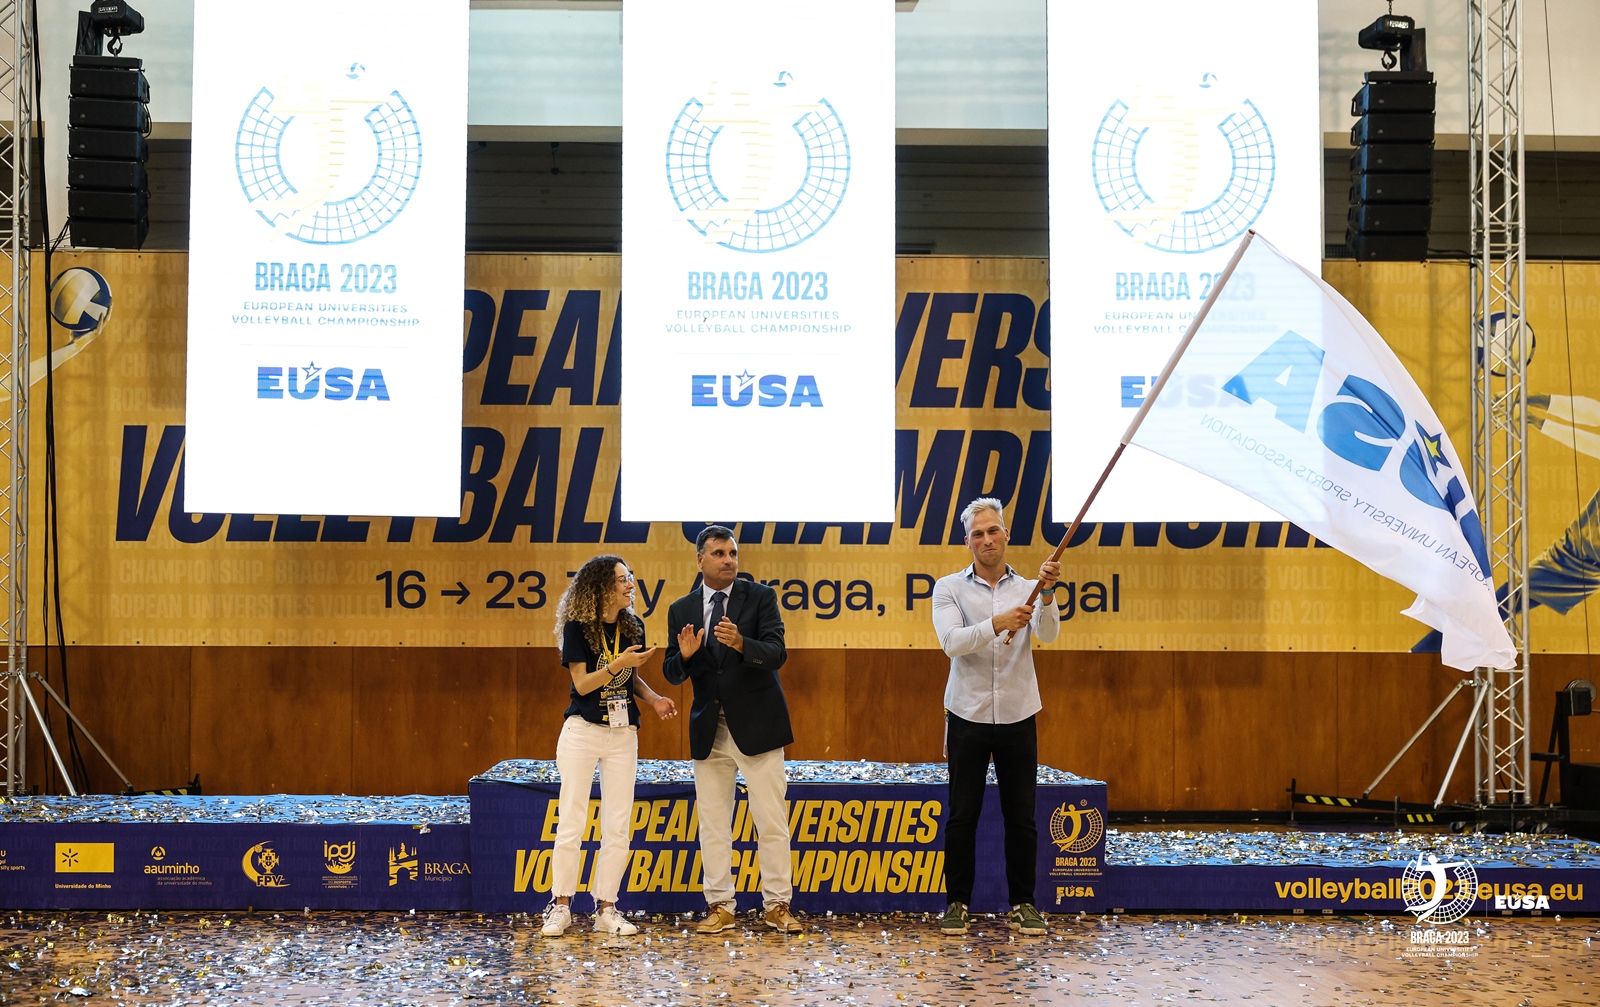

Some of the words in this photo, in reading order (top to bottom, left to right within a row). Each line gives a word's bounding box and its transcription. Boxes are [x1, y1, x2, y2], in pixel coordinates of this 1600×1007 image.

[255, 262, 331, 292] BRAGA
[340, 263, 397, 294] 2023
[688, 271, 763, 300] BRAGA
[772, 271, 828, 300] 2023
[1115, 272, 1191, 301] BRAGA
[243, 301, 313, 311] EUROPEAN
[318, 303, 408, 313] UNIVERSITIES
[232, 315, 312, 325] VOLLEYBALL
[318, 316, 420, 326] CHAMPIONSHIP
[677, 310, 746, 319] EUROPEAN
[751, 310, 839, 320] UNIVERSITIES
[1105, 312, 1174, 320] EUROPEAN
[665, 324, 746, 333] VOLLEYBALL
[751, 324, 851, 333] CHAMPIONSHIP
[1094, 325, 1173, 334] VOLLEYBALL
[257, 362, 390, 401] EUSA
[692, 369, 824, 408] EUSA
[376, 571, 426, 609] 16
[486, 571, 546, 609] 23
[324, 840, 355, 863] ipdj
[1055, 857, 1077, 866] BRAGA
[1079, 857, 1096, 866] 2023
[144, 862, 200, 874] aauminho
[424, 862, 471, 875] BRAGA
[256, 874, 283, 886] FPV
[1056, 886, 1094, 897] EUSA
